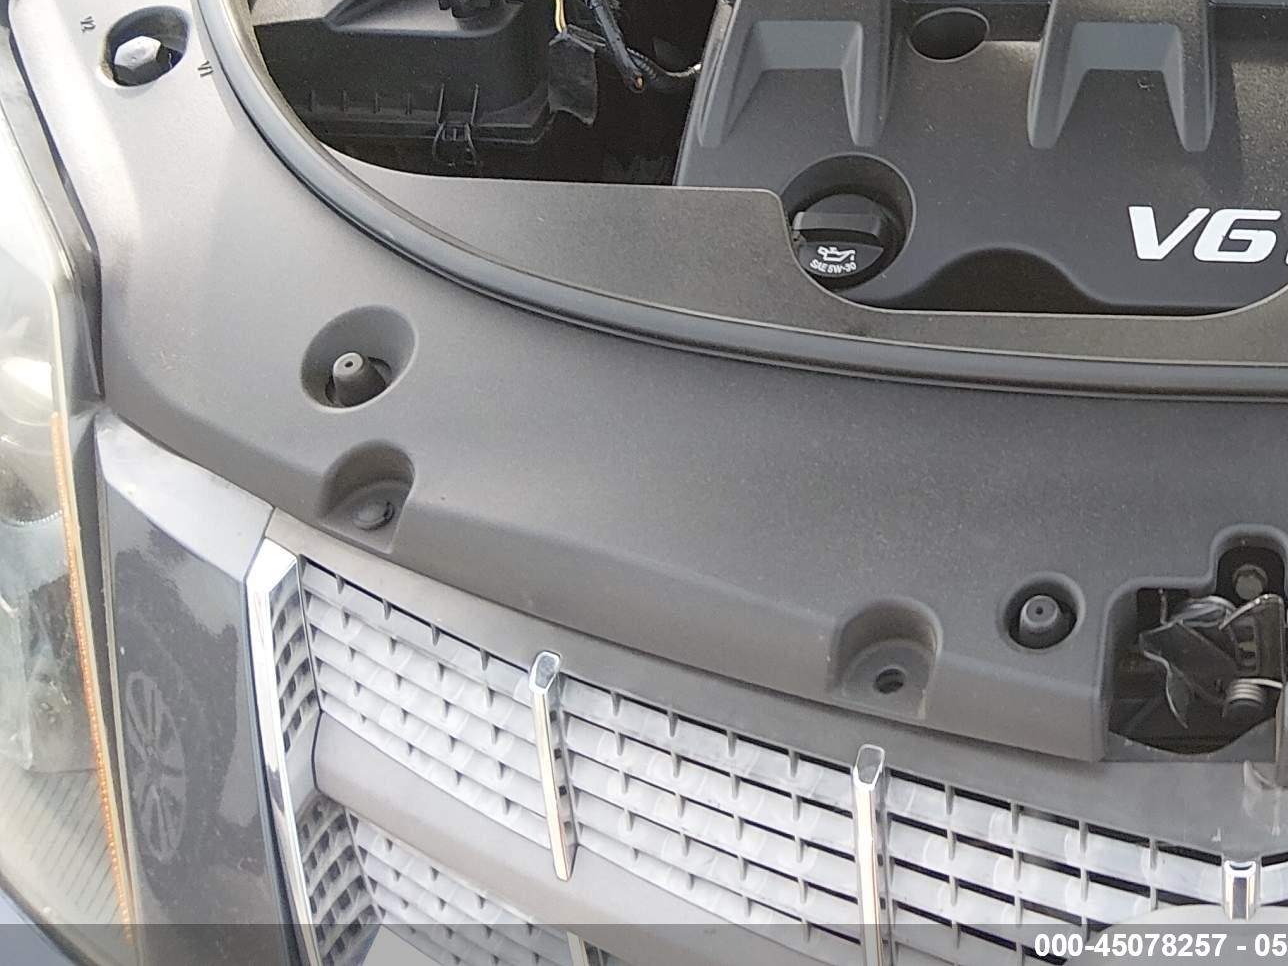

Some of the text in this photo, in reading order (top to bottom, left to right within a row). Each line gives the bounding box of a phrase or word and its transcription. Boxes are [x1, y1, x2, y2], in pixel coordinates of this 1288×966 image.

[1128, 206, 1282, 263] V6
[809, 258, 857, 274] SAE 5W-30
